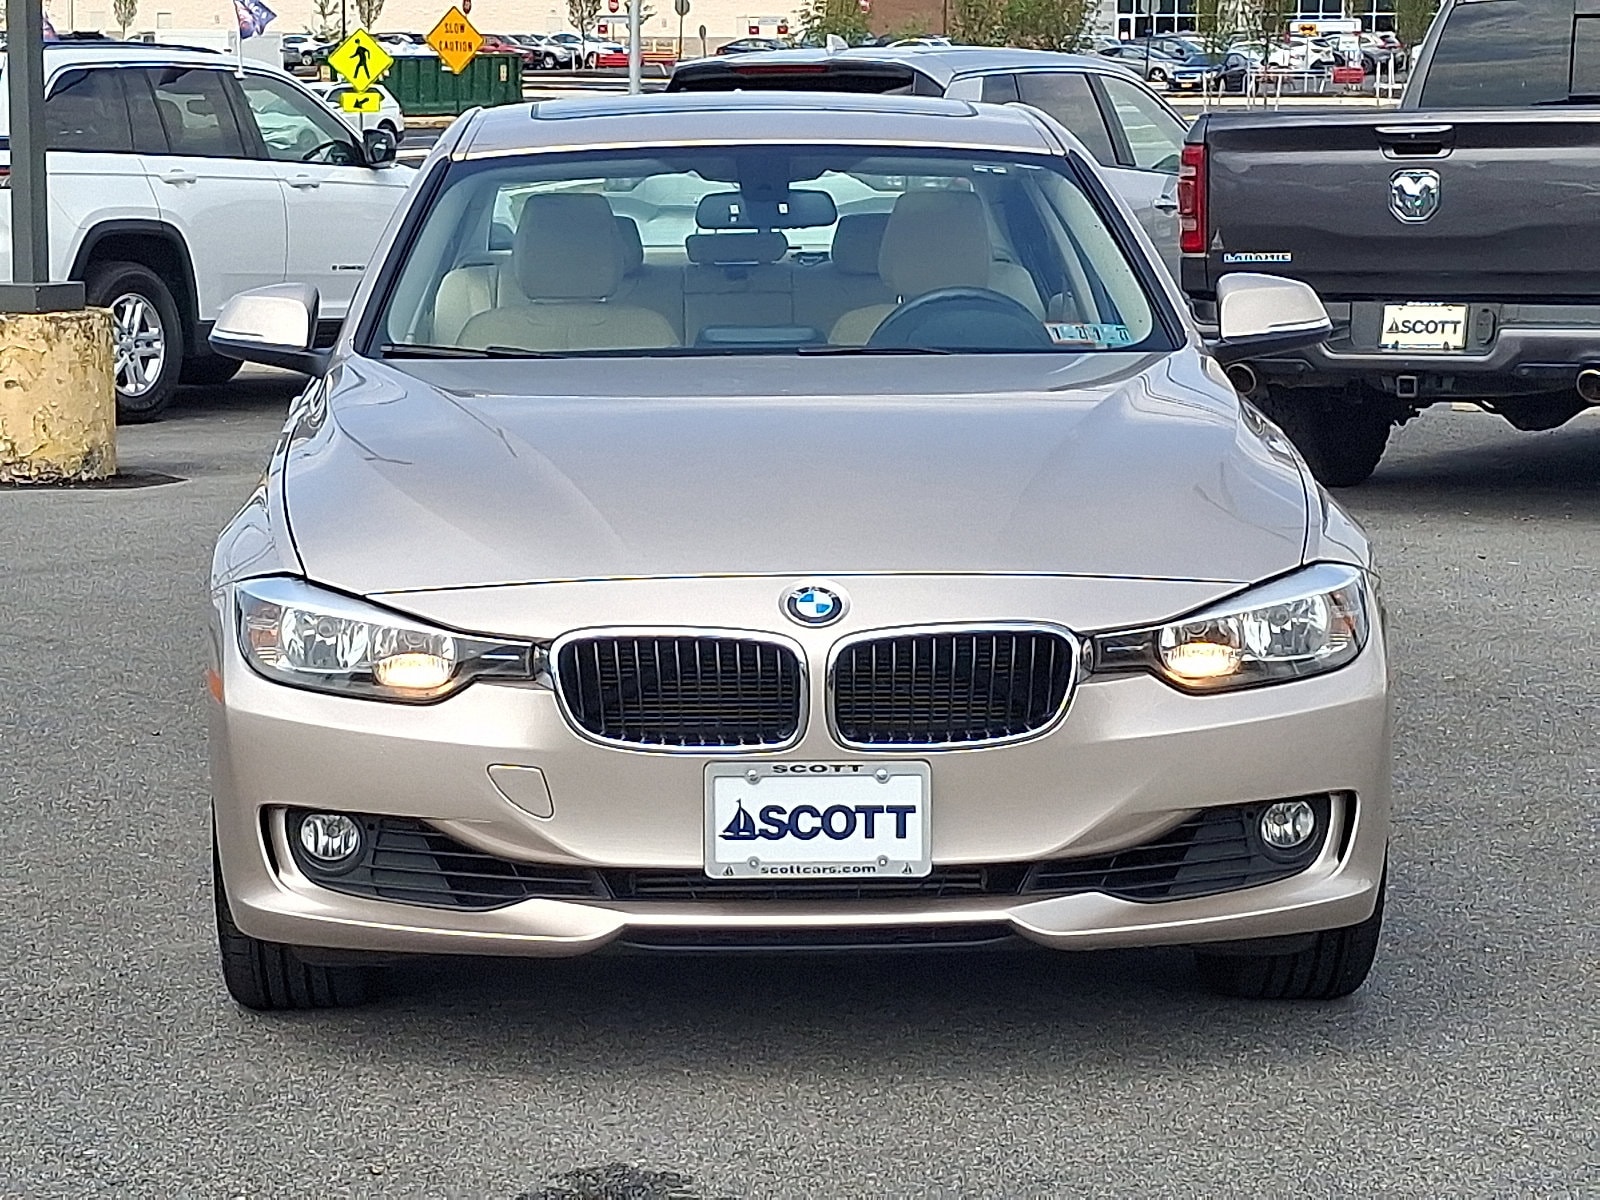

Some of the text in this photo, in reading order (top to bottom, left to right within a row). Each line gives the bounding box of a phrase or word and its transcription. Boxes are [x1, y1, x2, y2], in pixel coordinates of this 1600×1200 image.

[444, 22, 465, 34] SLOW
[439, 41, 472, 52] CAUTION
[1400, 319, 1462, 335] SCOTT
[772, 764, 865, 773] SCOTT
[759, 804, 916, 840] SCOTT
[760, 865, 876, 875] scottcars.com
